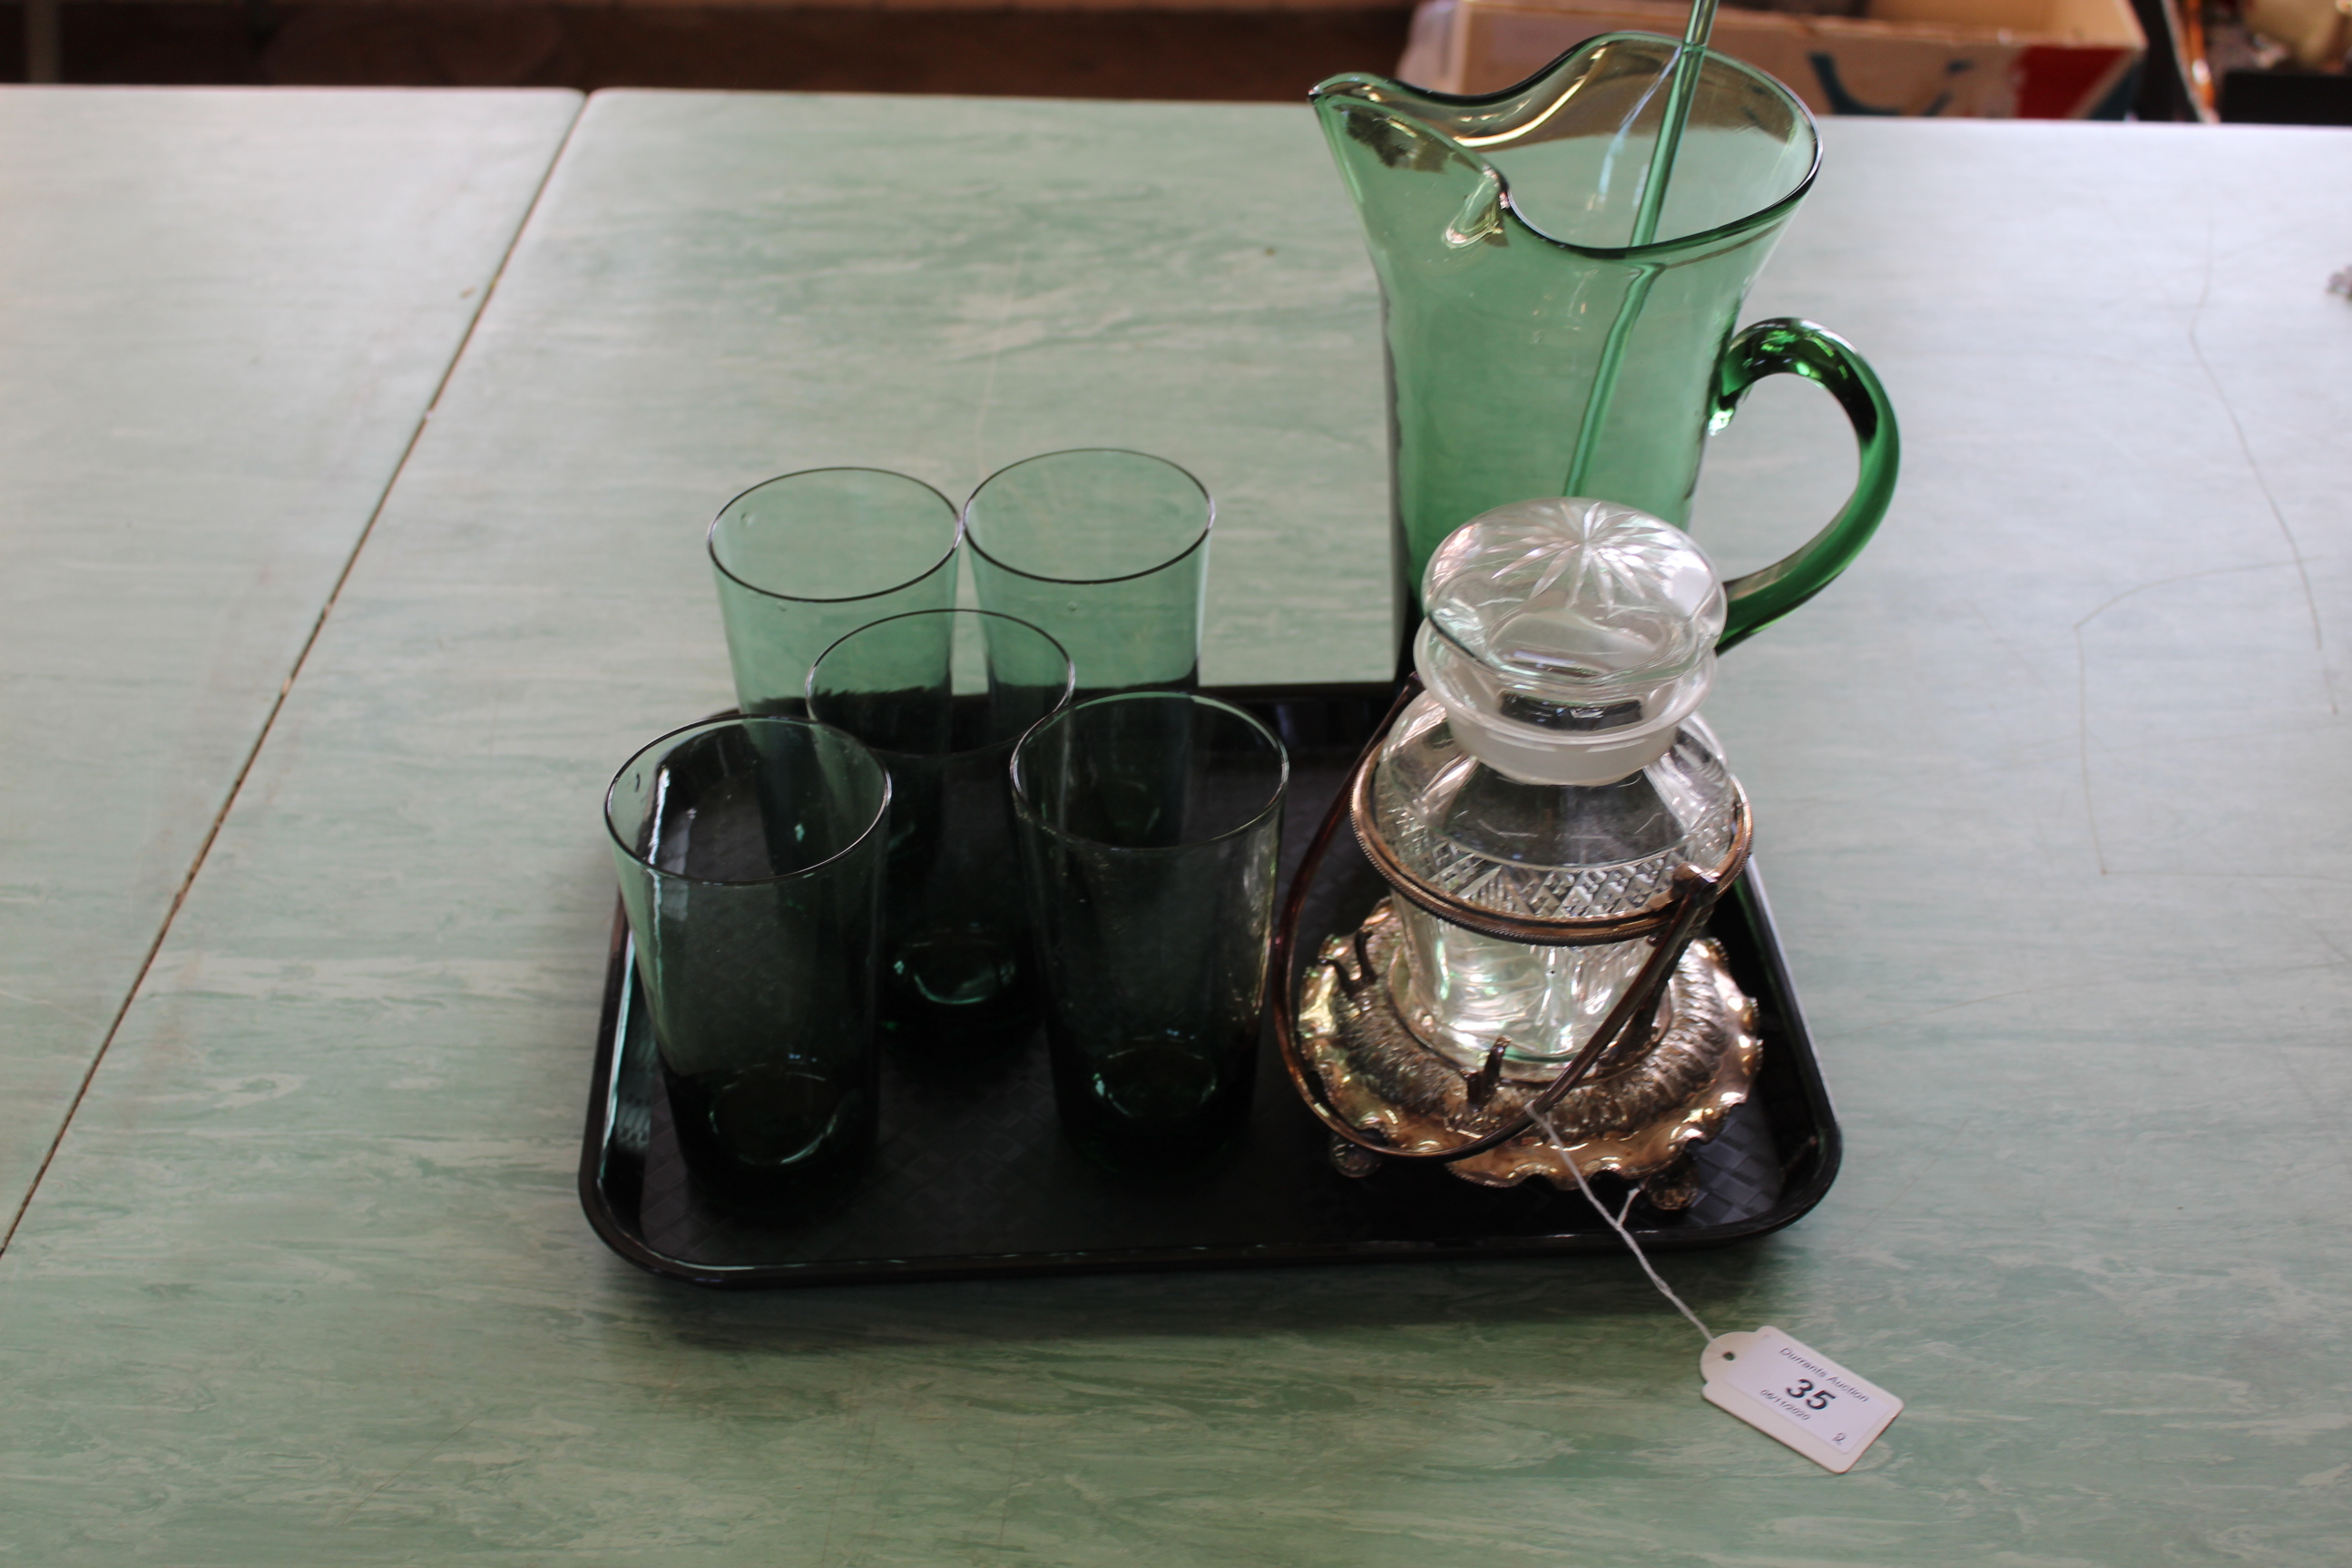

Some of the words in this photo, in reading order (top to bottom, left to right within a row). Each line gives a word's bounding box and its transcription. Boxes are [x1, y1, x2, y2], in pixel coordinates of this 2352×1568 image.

[1779, 1347, 1827, 1377] Durrants
[1827, 1376, 1870, 1403] Auction
[1786, 1378, 1836, 1410] 35
